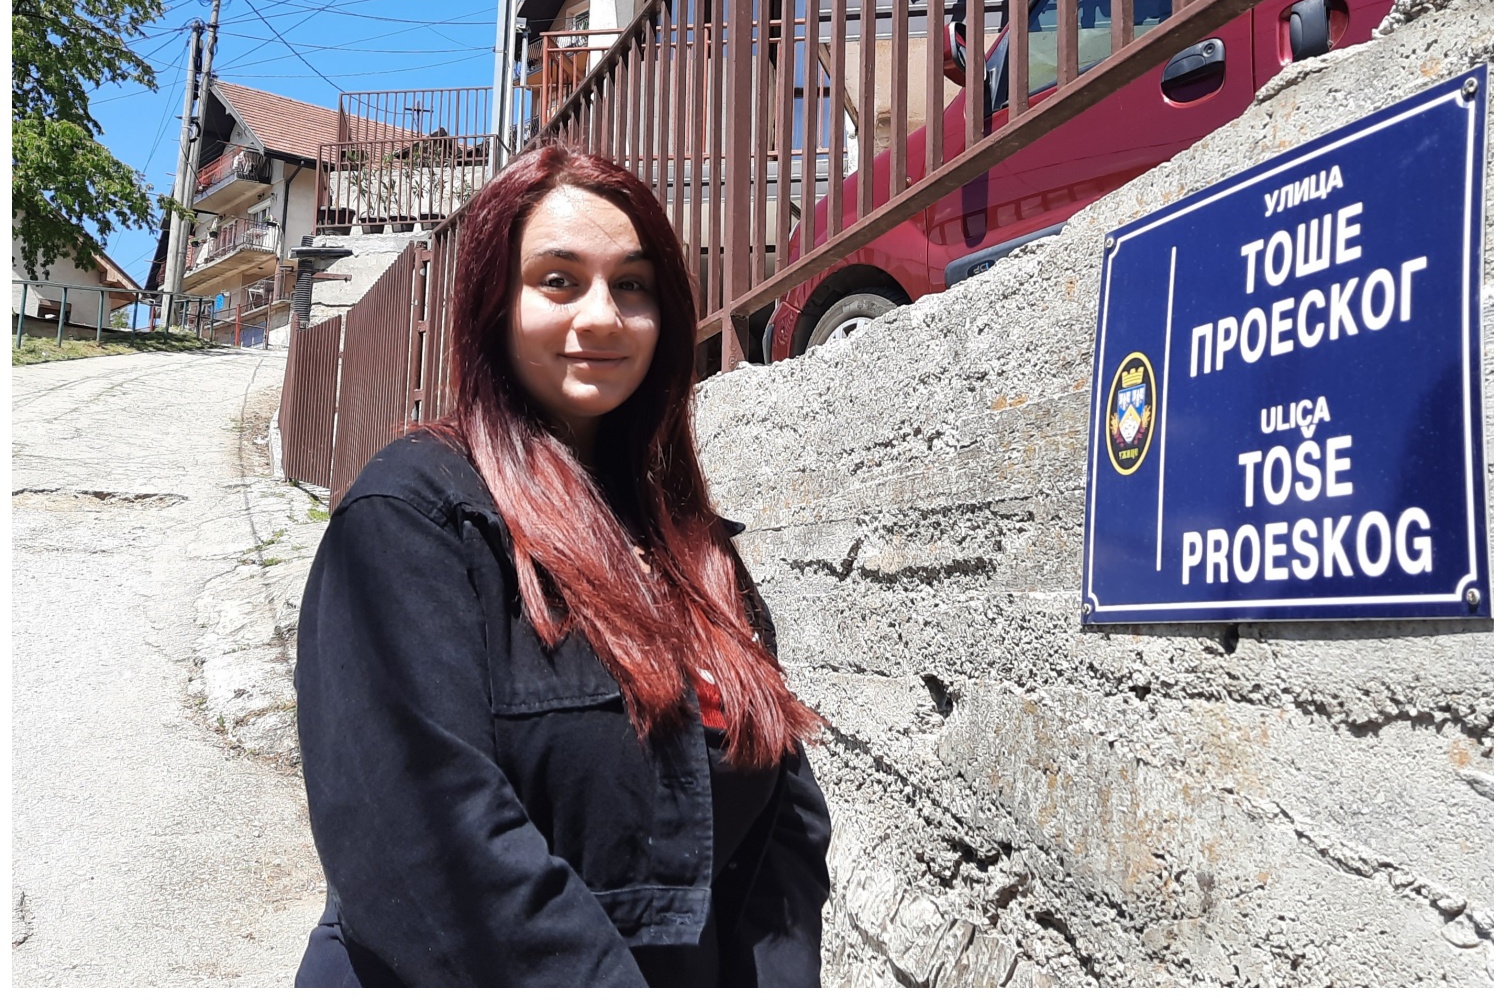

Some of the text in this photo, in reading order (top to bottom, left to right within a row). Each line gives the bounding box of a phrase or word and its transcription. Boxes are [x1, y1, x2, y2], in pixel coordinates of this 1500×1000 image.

[1264, 164, 1344, 218] УЛИЦА
[1240, 201, 1364, 294] ТОШЕ
[1189, 255, 1428, 378] ПРОЕСКОГ
[1260, 395, 1331, 435] ULICA
[1238, 421, 1354, 508] TOŠE
[1181, 506, 1433, 586] PROESKOG
